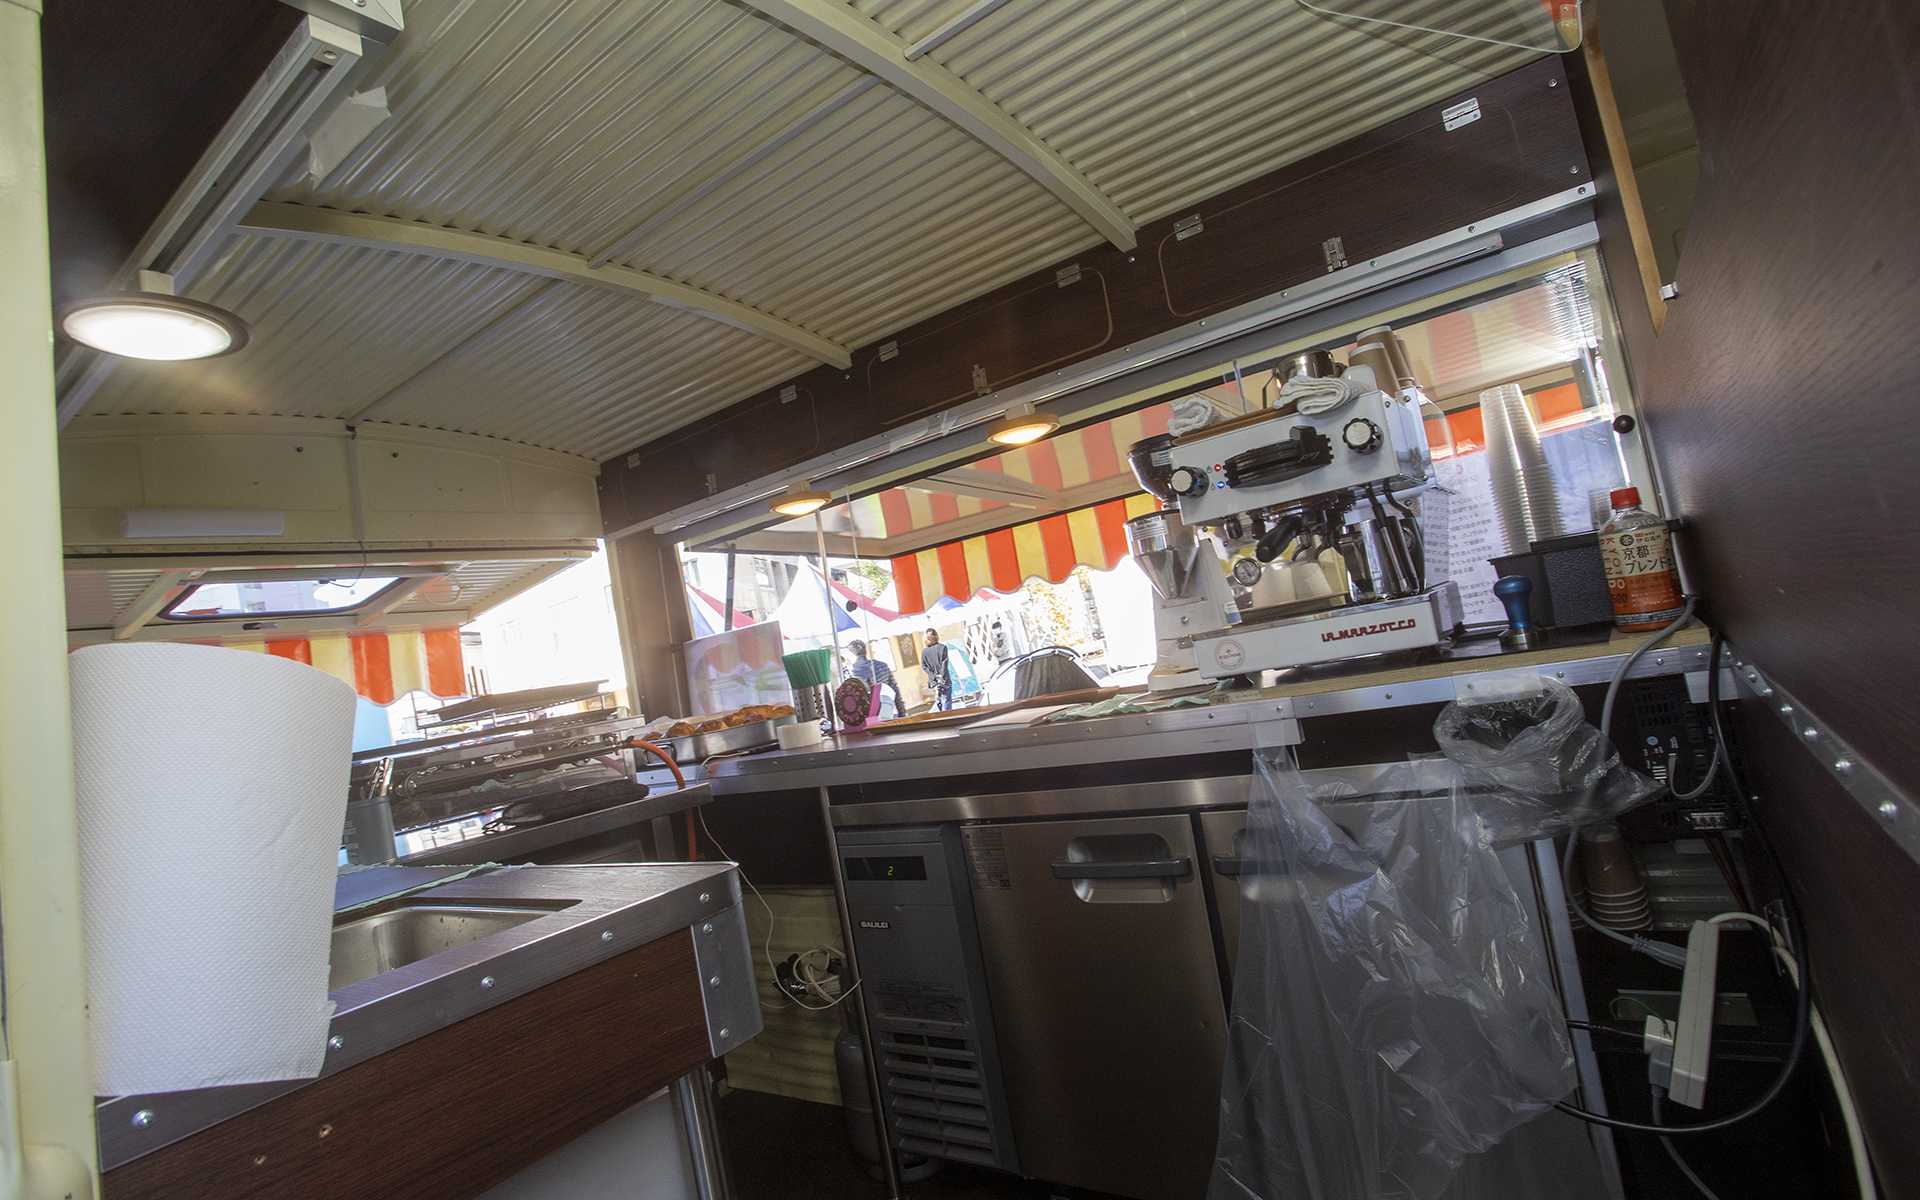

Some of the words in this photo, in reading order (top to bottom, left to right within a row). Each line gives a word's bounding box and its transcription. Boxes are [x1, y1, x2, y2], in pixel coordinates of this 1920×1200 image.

[1621, 545, 1650, 560] 京都
[1606, 537, 1625, 589] KYOTO
[1625, 557, 1667, 574] ブレンド
[887, 866, 894, 876] 2
[860, 921, 889, 929] GALILEI
